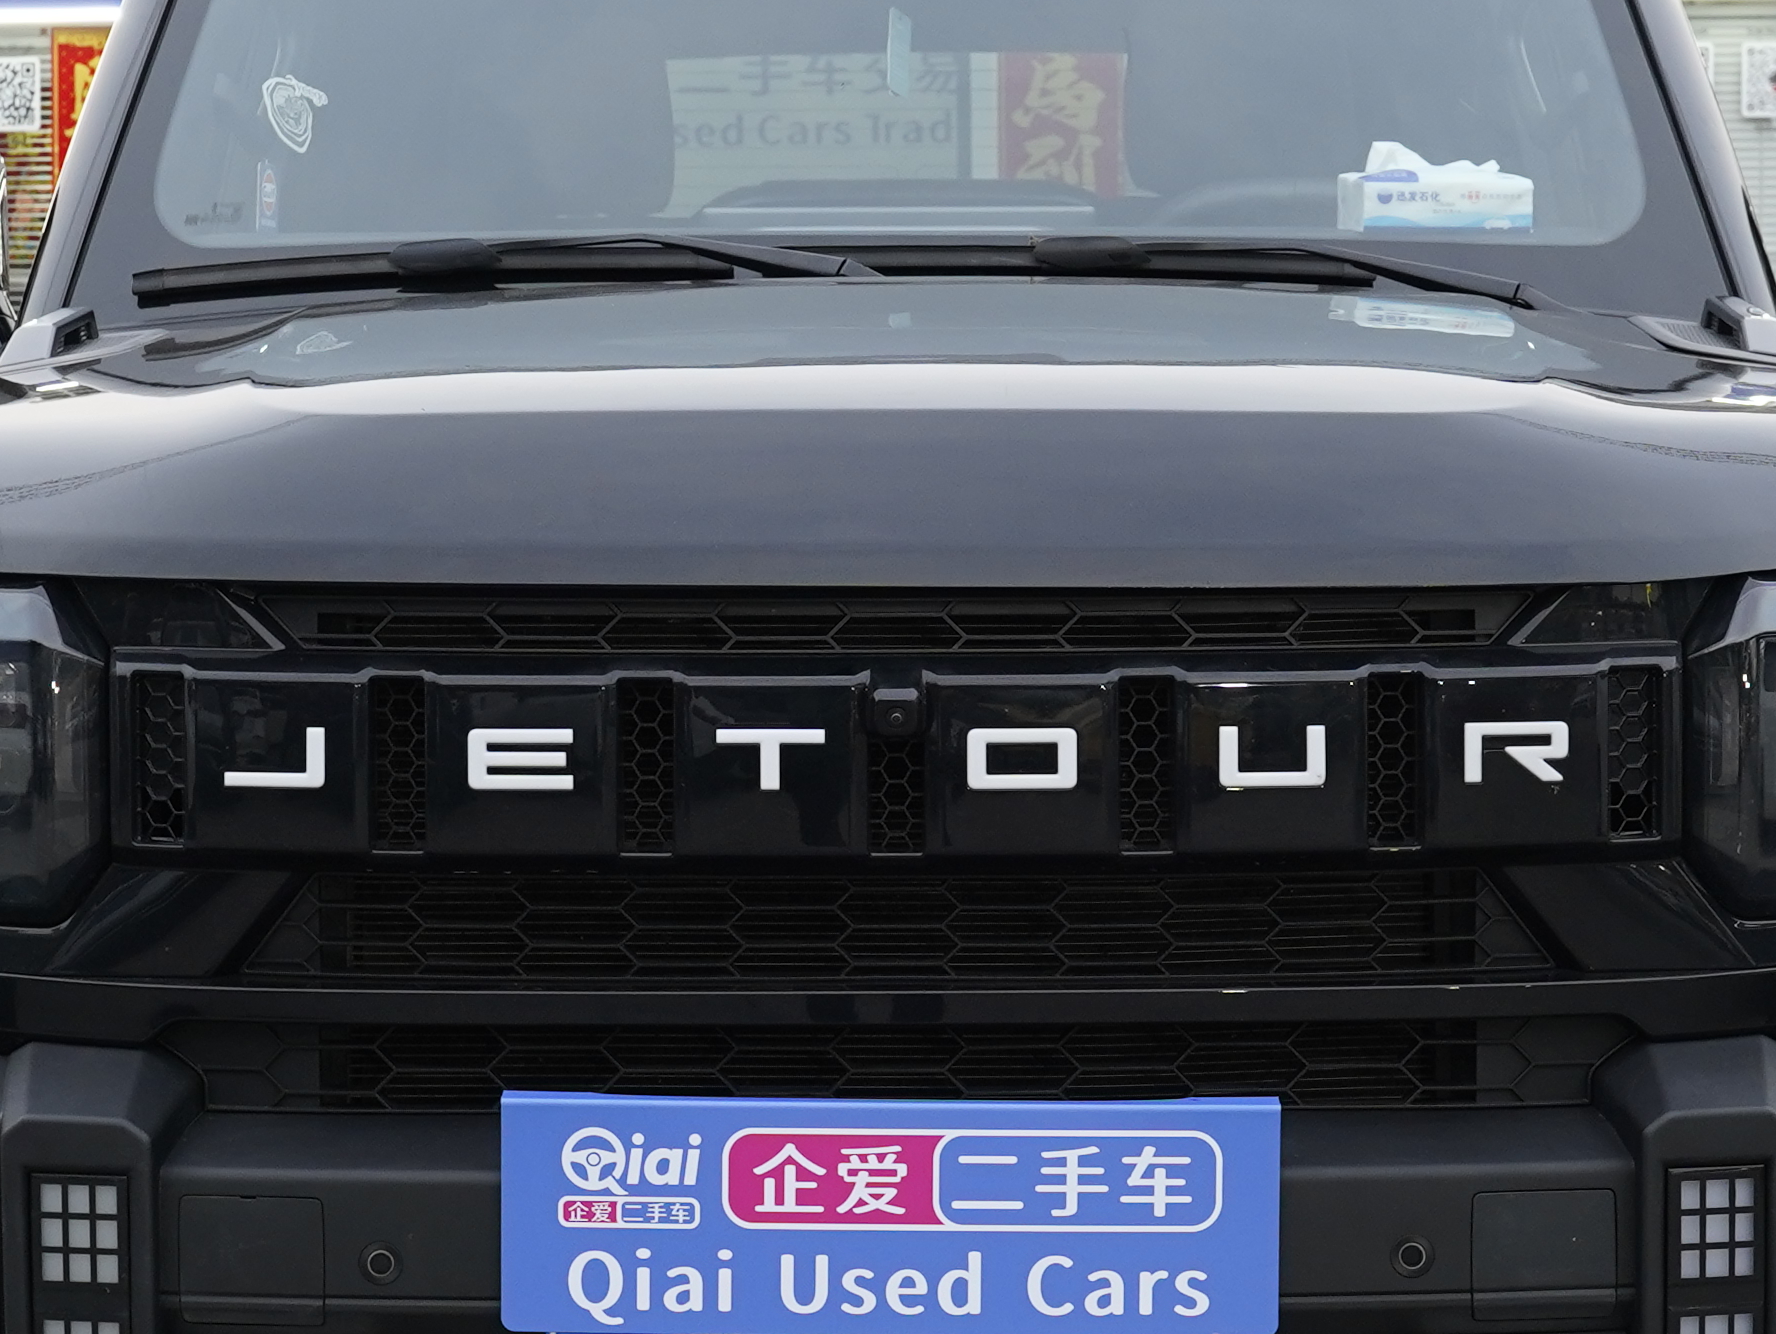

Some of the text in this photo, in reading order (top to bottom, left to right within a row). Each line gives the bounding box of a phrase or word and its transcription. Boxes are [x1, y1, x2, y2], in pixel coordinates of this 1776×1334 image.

[758, 113, 852, 147] Cars
[223, 721, 1572, 793] JETOUR
[560, 1126, 703, 1196] Qiai
[567, 1246, 1211, 1325] Qiai Used Cars
